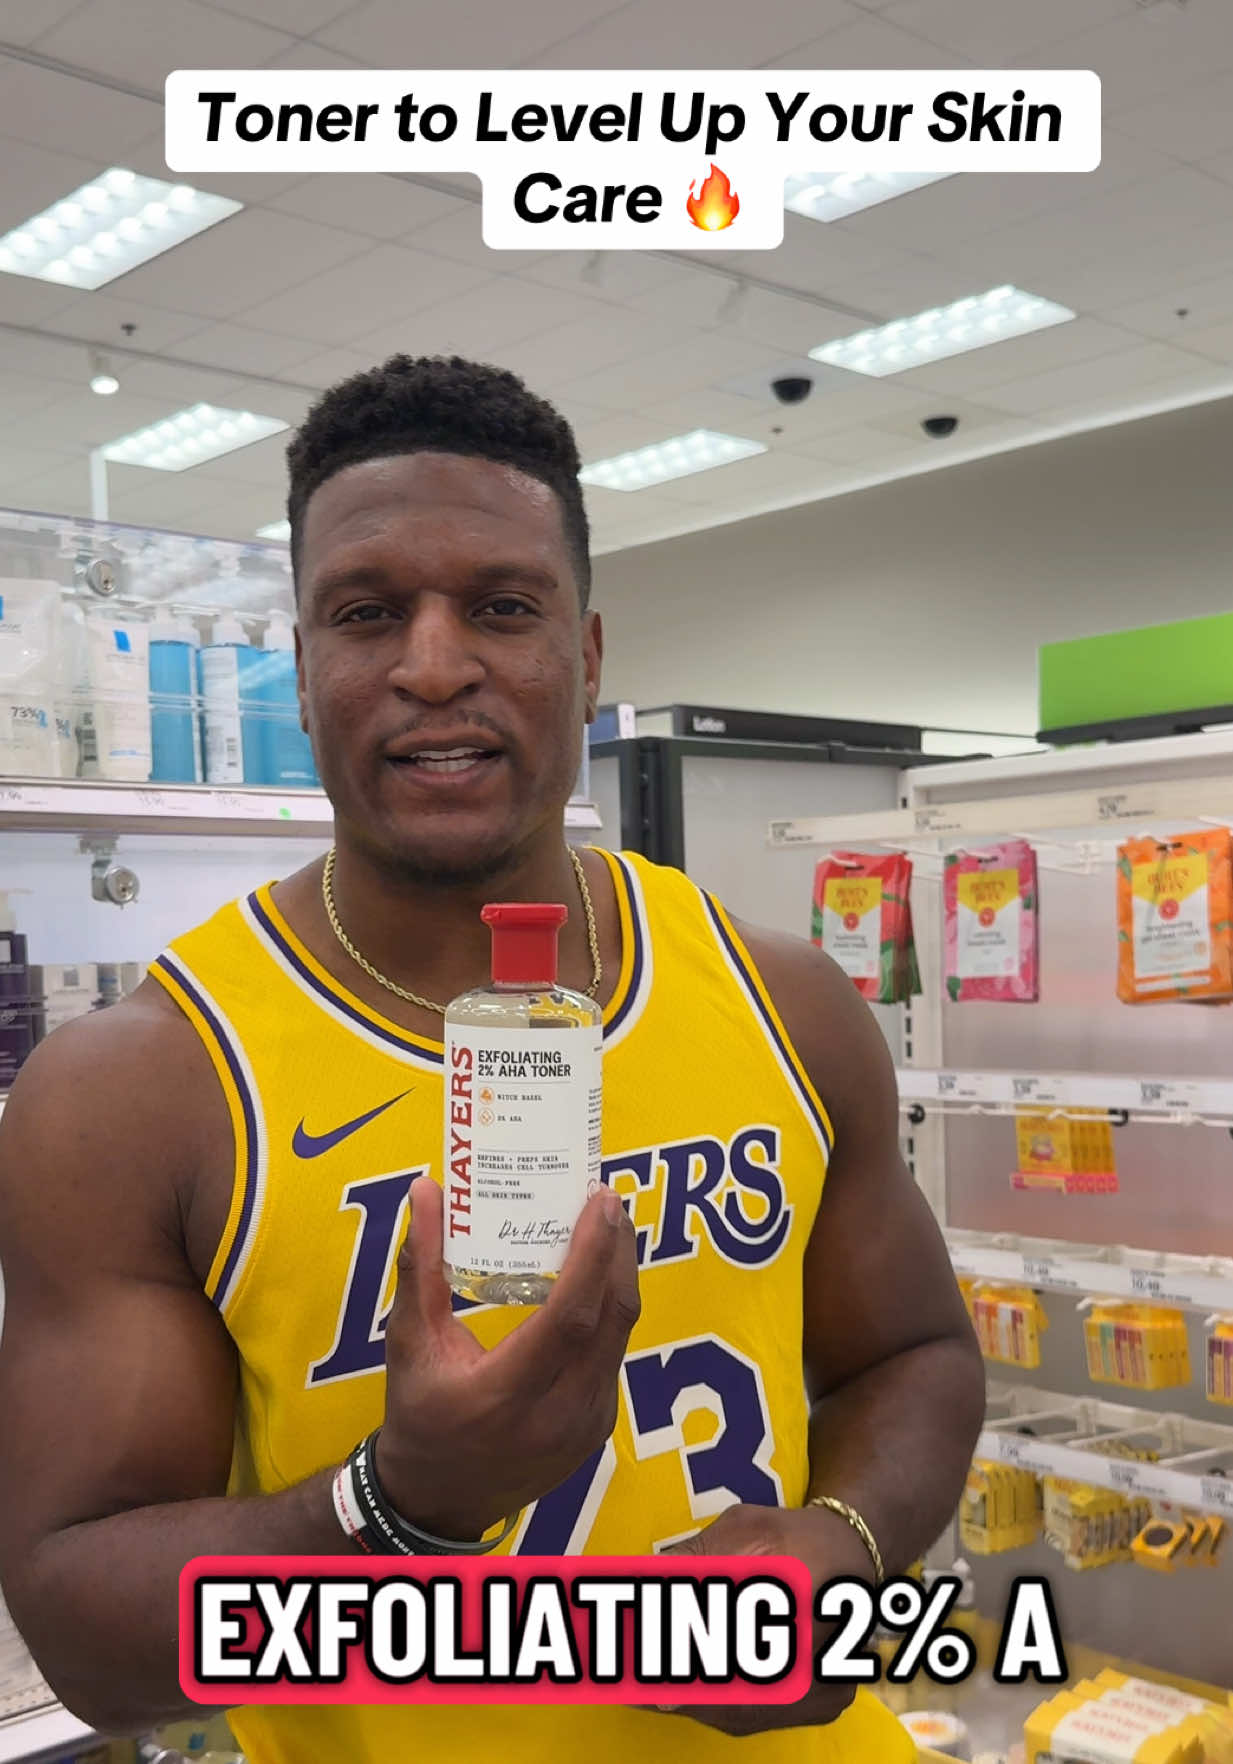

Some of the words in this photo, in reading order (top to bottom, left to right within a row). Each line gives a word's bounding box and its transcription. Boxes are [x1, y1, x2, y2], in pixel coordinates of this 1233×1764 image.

[477, 1049, 562, 1064] EXFOLIATING
[477, 1064, 494, 1077] 2%
[498, 1064, 527, 1077] AHA
[530, 1064, 571, 1078] TONER
[450, 1046, 473, 1238] THAYERS
[477, 1154, 505, 1162] REFINES
[477, 1162, 513, 1170] INCREASES
[482, 1258, 491, 1266] FL
